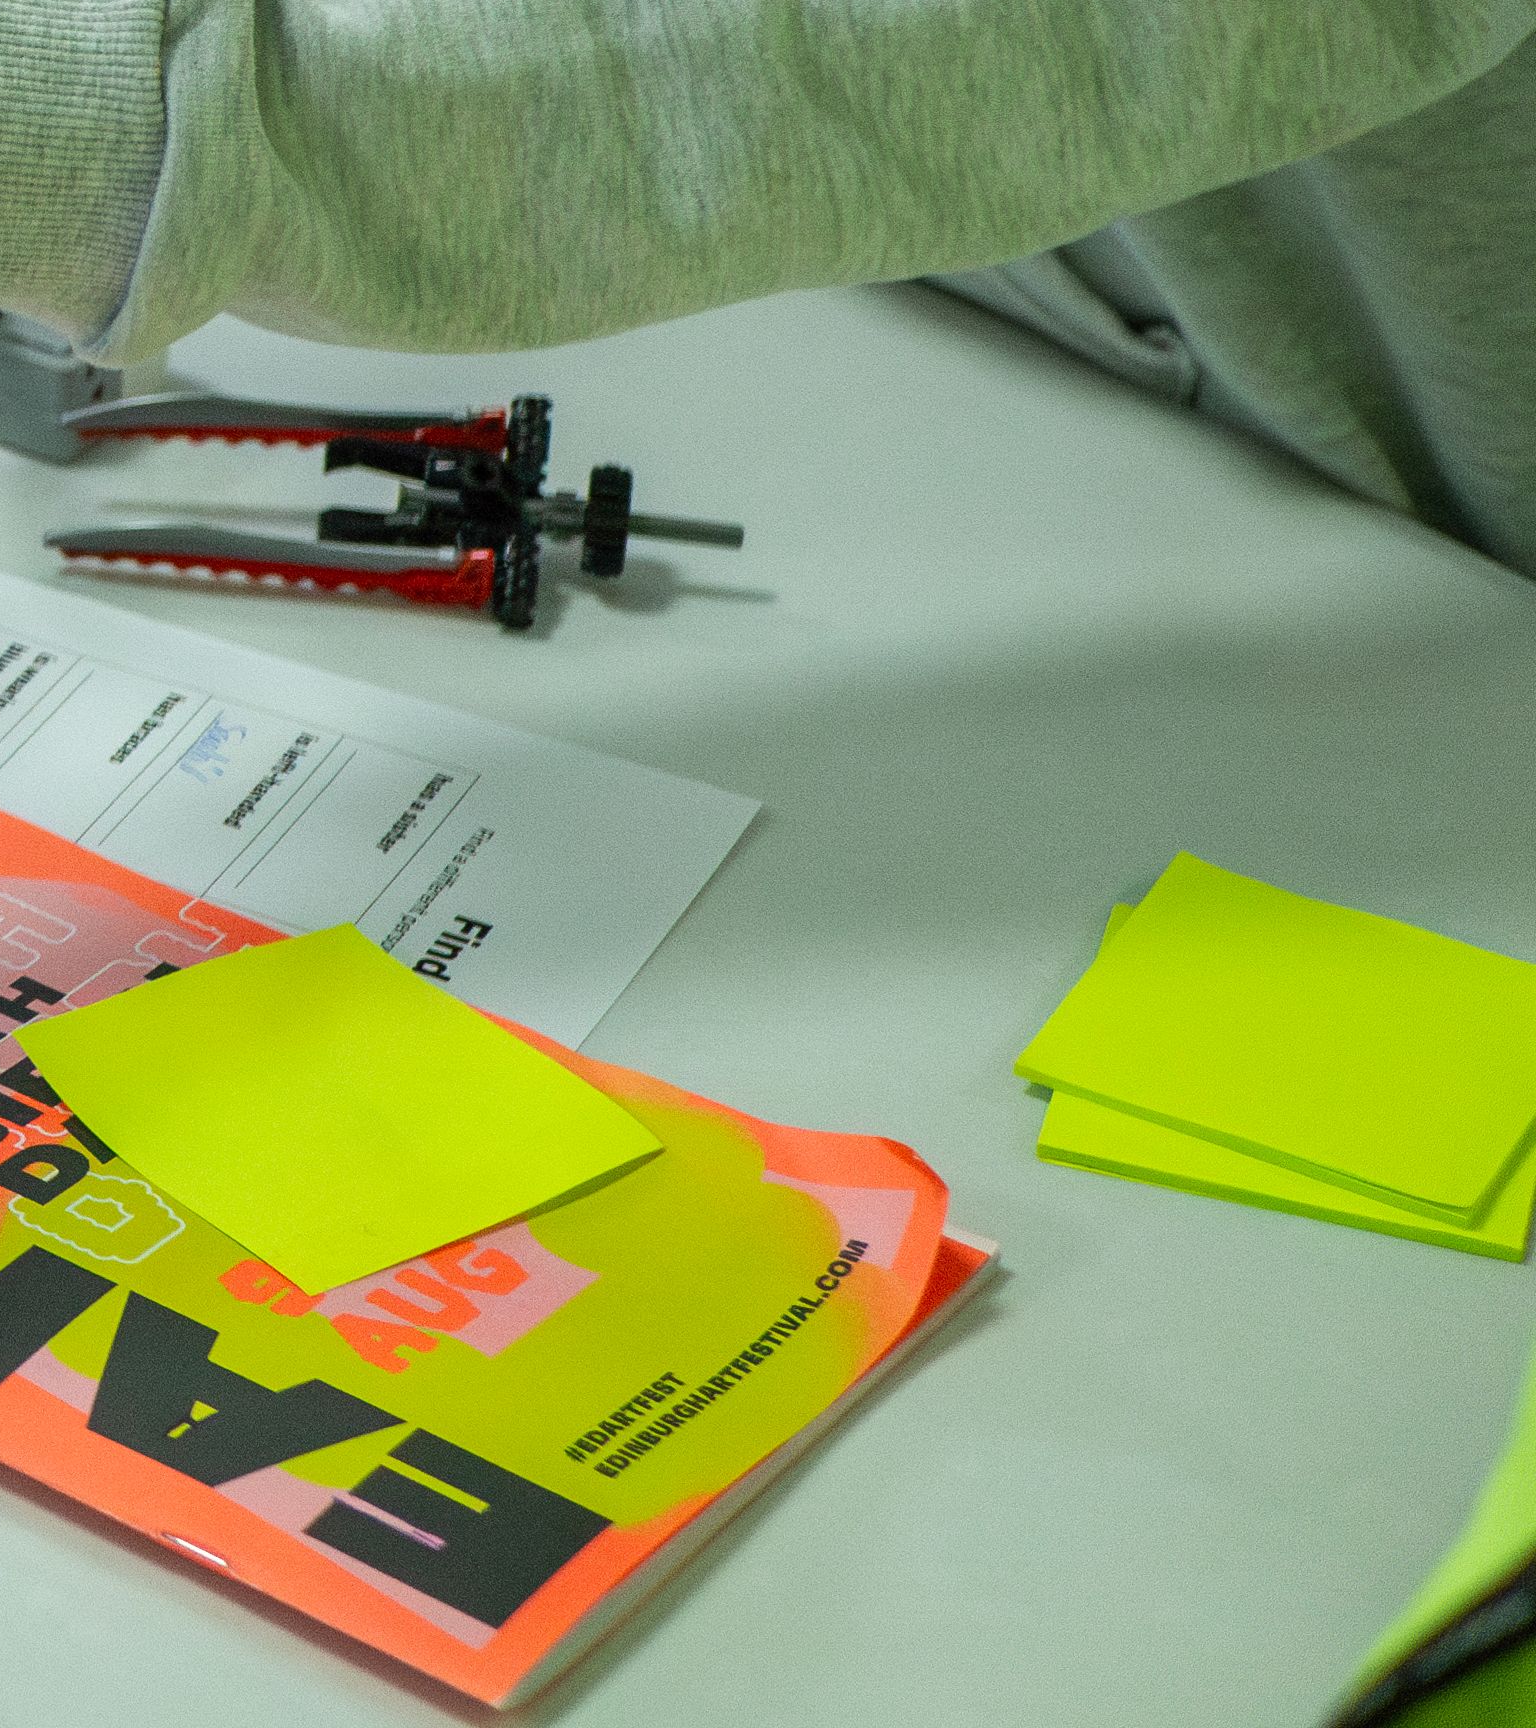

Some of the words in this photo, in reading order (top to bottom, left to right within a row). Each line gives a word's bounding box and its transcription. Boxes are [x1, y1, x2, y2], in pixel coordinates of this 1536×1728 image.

[380, 912, 417, 954] perso
[411, 914, 494, 982] Find
[330, 1239, 529, 1375] AUG
[593, 1238, 870, 1480] EDINBURGHARTFESTIVAL.COM
[564, 1371, 686, 1465] #EDARTFEST
